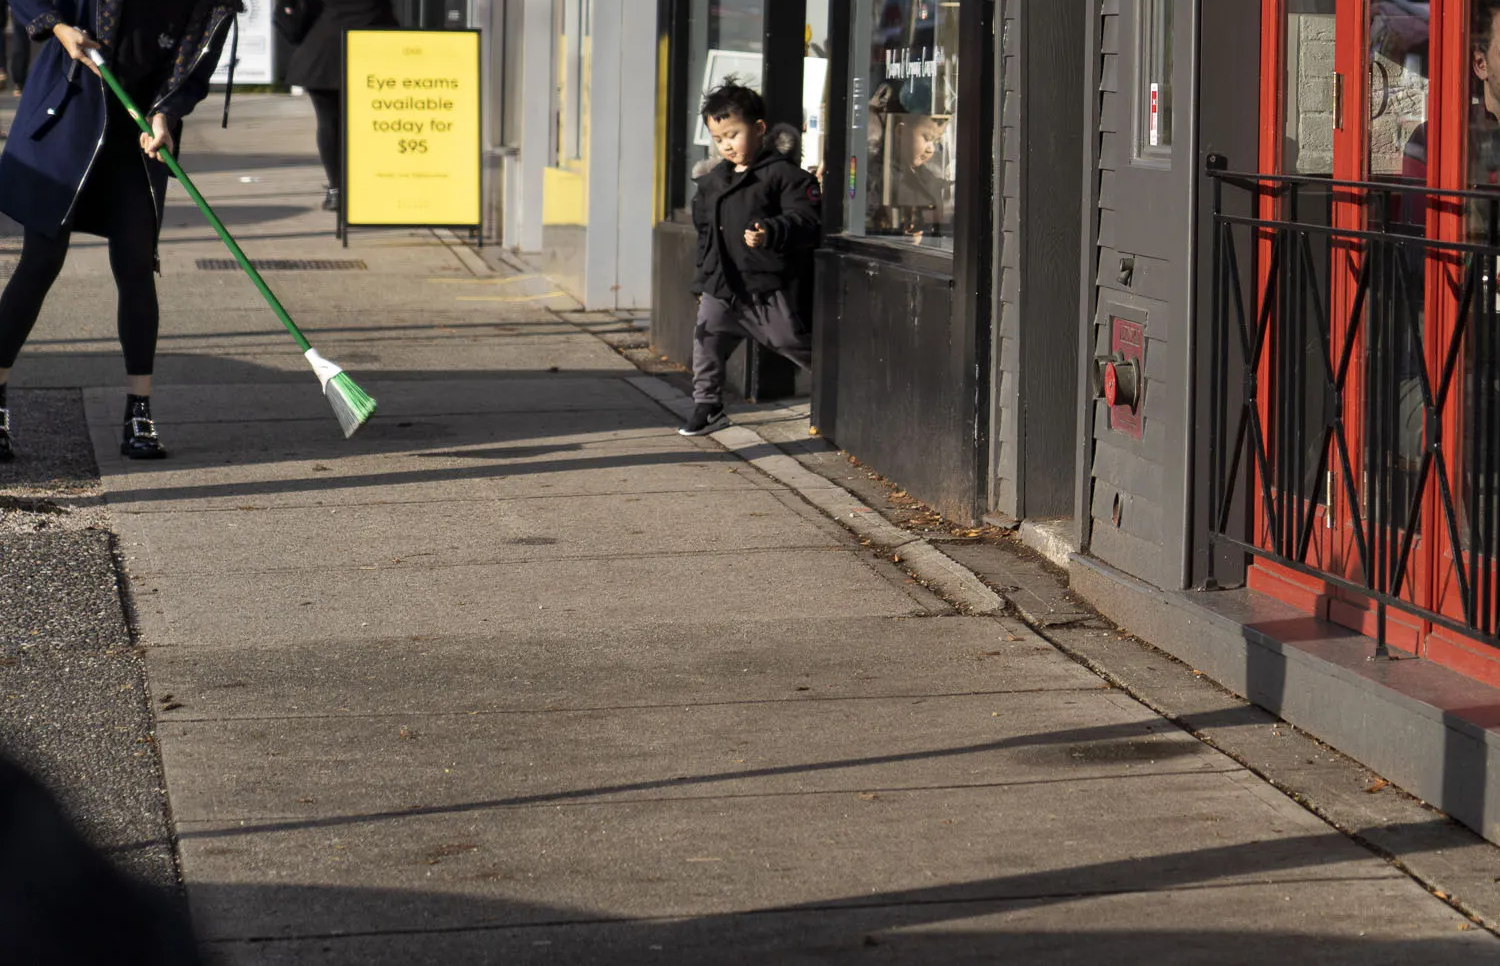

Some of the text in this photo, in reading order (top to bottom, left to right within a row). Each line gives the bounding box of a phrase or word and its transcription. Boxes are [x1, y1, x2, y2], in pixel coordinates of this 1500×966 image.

[366, 74, 459, 91] Eye exams
[371, 96, 453, 111] available
[373, 118, 453, 134] today for
[398, 139, 428, 154] $95
